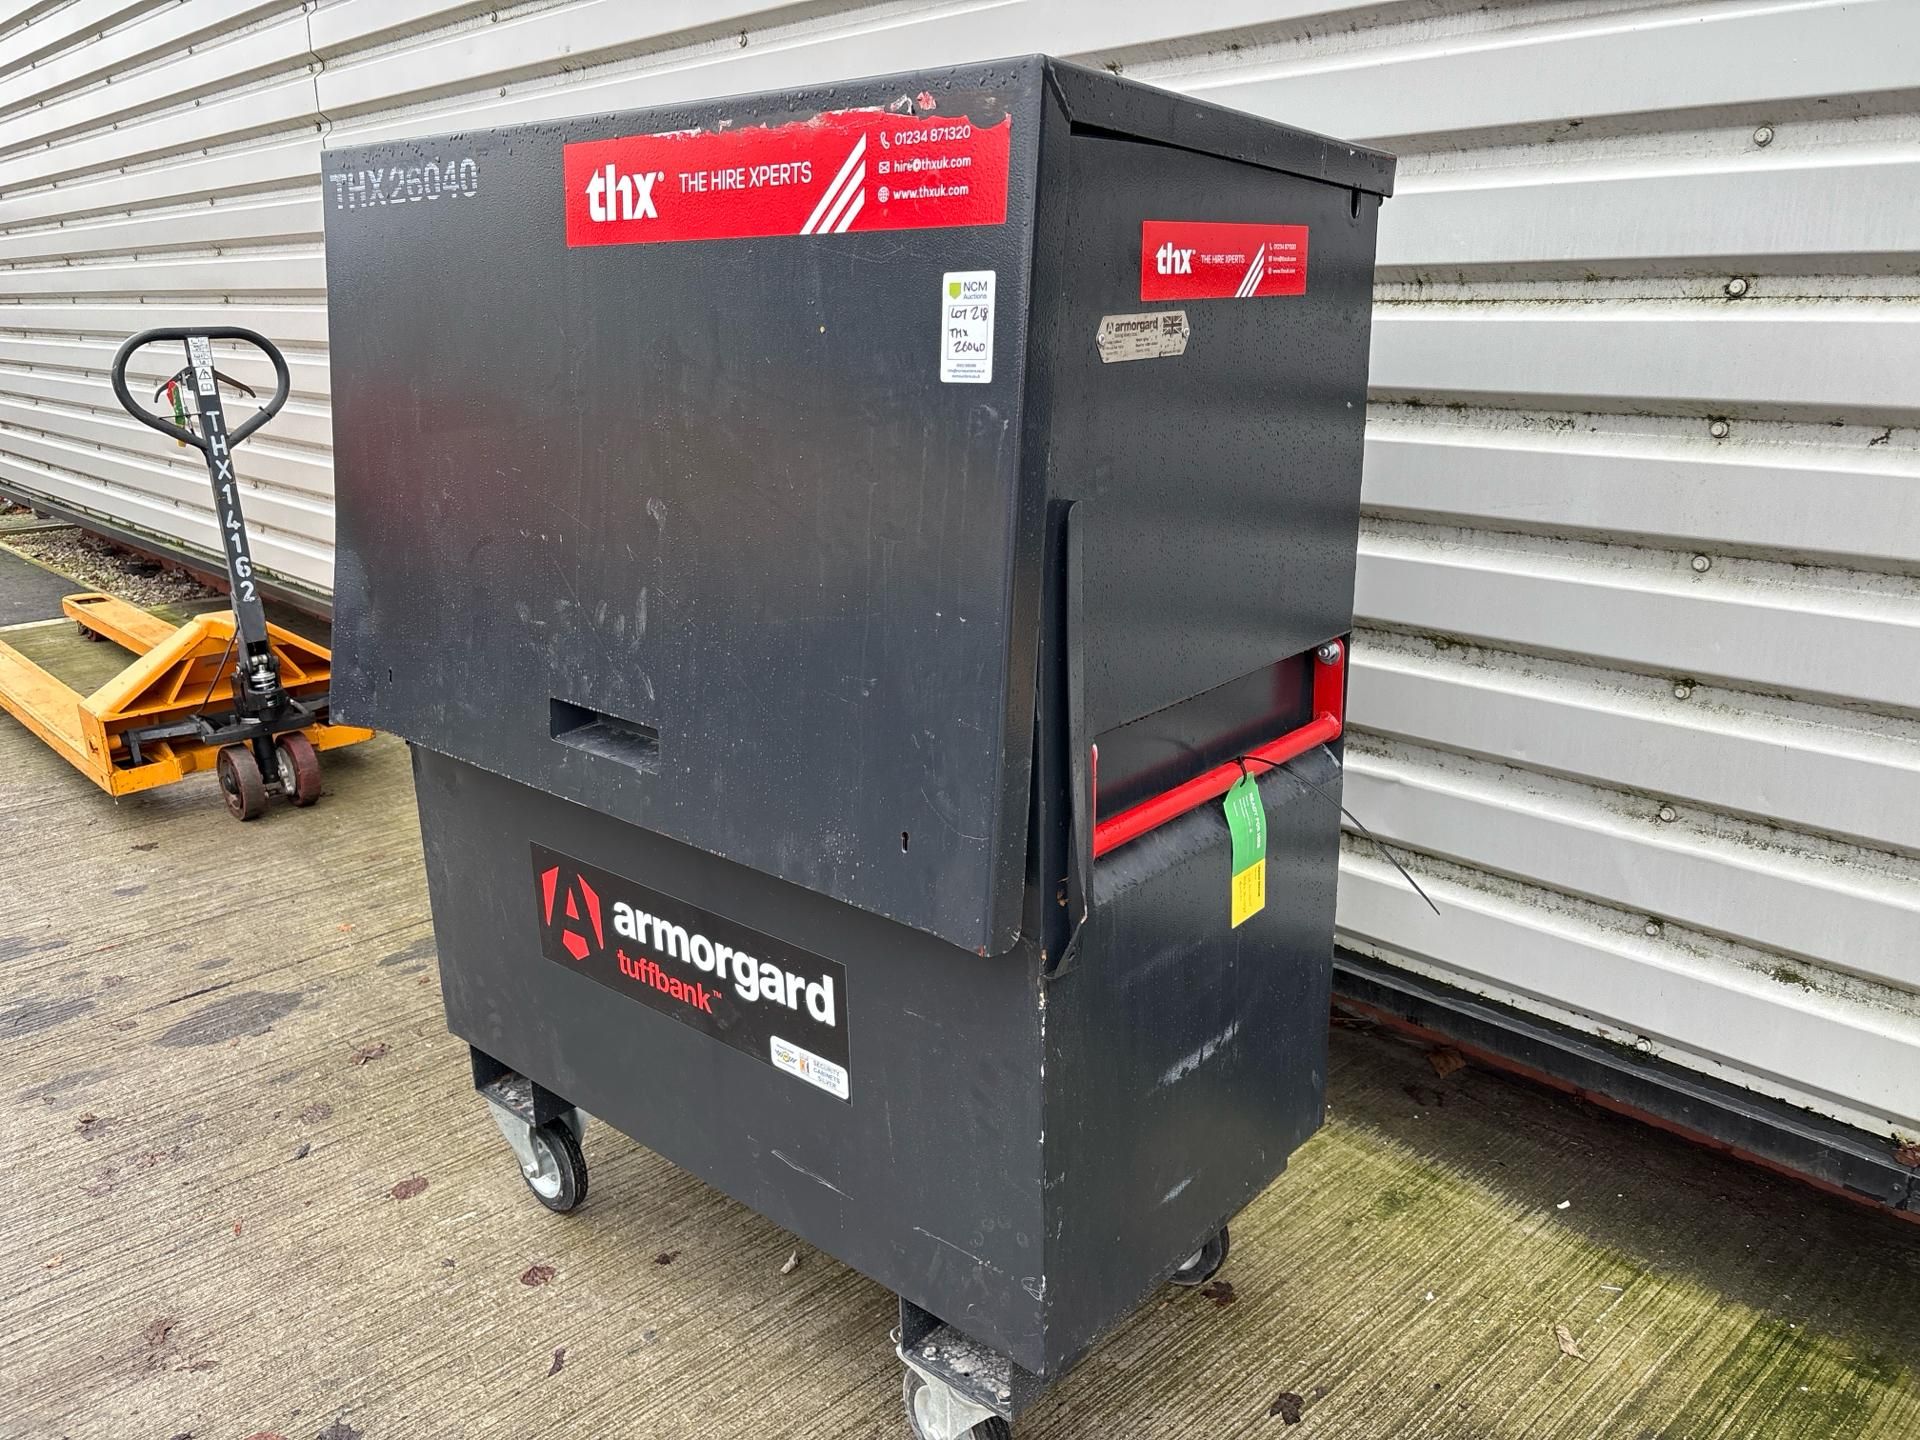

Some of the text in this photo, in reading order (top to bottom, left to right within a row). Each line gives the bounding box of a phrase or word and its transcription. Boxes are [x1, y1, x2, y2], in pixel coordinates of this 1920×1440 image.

[895, 125, 971, 145] 01234 871320
[893, 156, 972, 173] hire@thxuk.com
[329, 157, 478, 209] THX26040
[679, 171, 708, 194] THE
[711, 168, 745, 191] HIRE
[748, 161, 812, 187] XPERTS
[893, 184, 969, 200] www.thxuk.com
[963, 280, 988, 292] NCM
[1114, 316, 1159, 333] armorgard
[953, 341, 986, 353] 26040
[205, 410, 256, 603] THX14162
[612, 901, 836, 1027] armorgard
